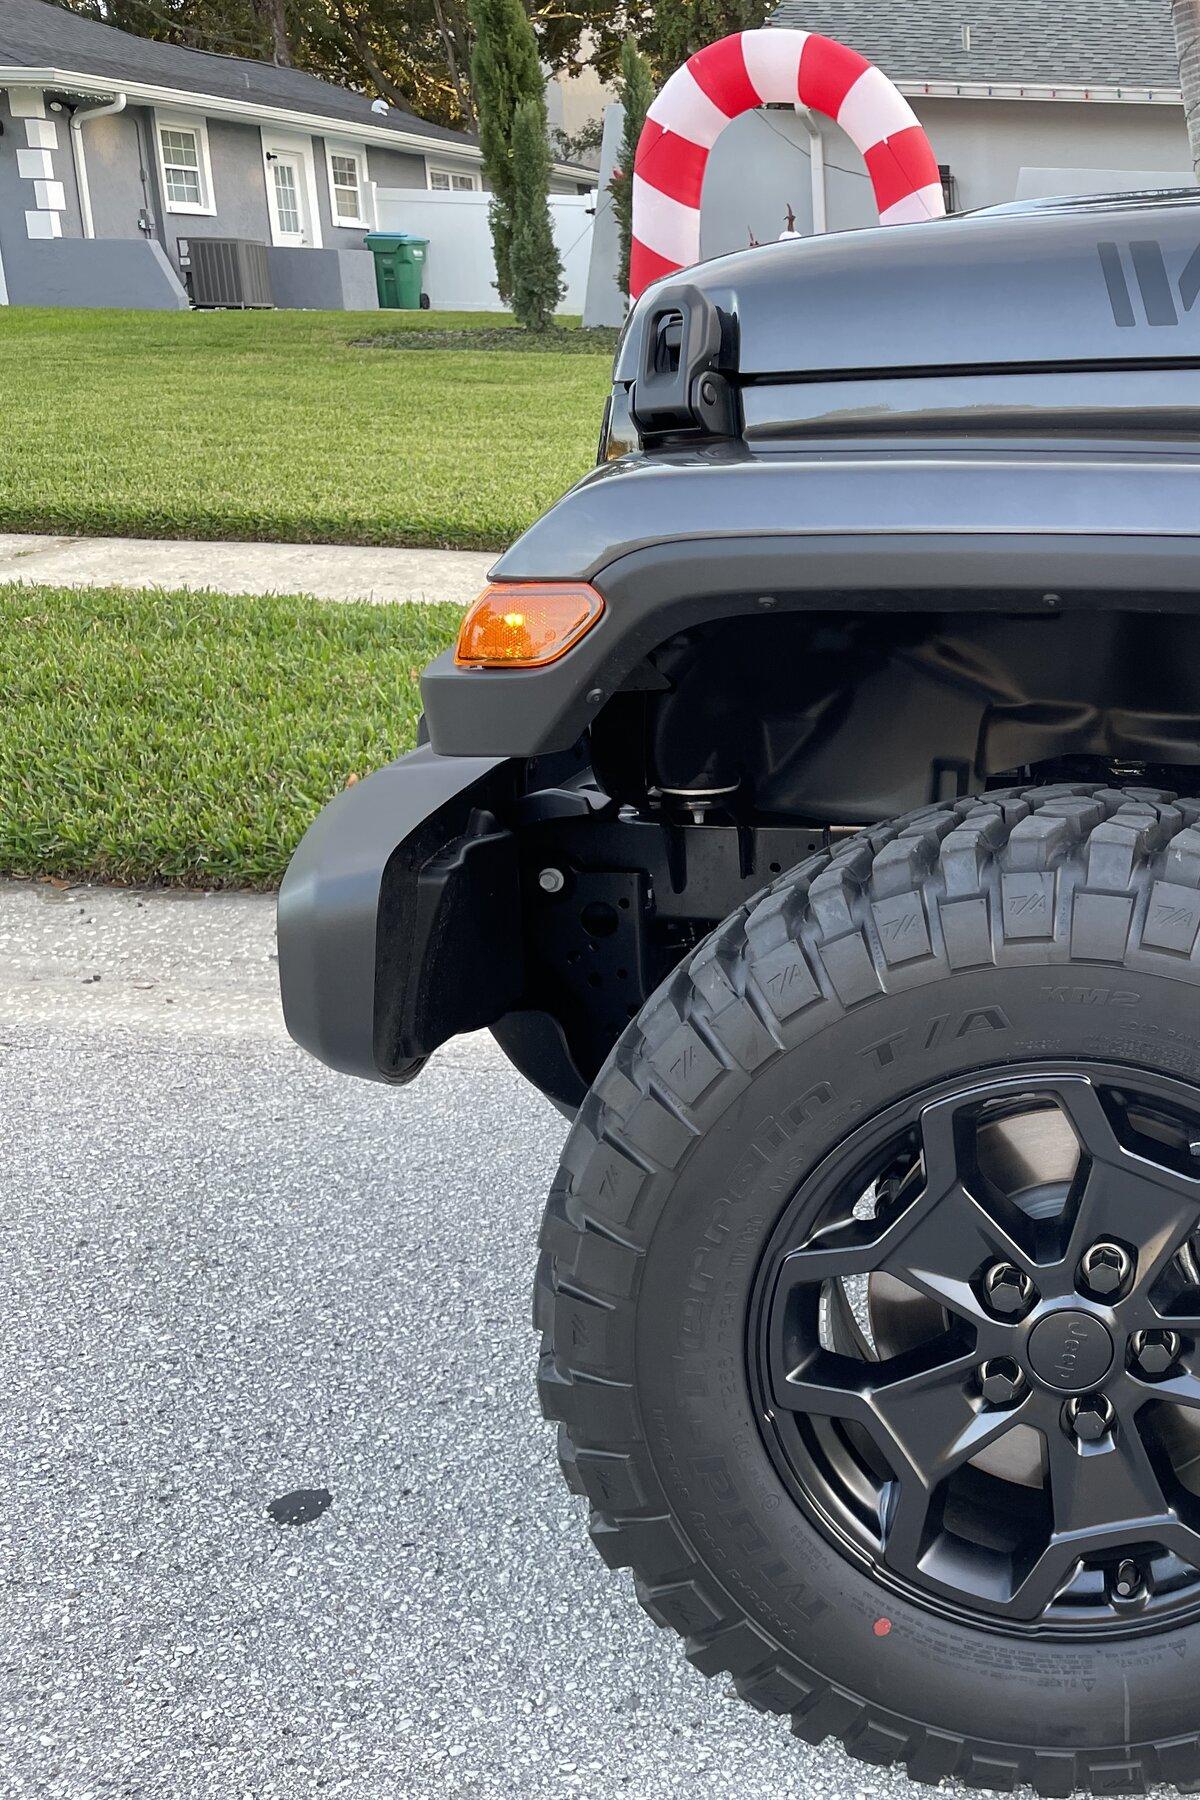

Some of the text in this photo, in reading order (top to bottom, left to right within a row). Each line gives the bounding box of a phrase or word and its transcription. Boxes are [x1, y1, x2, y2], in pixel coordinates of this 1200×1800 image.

[856, 1003, 1013, 1071] T/A
[1039, 985, 1143, 1008] KM2
[1055, 1321, 1088, 1379] Jeep
